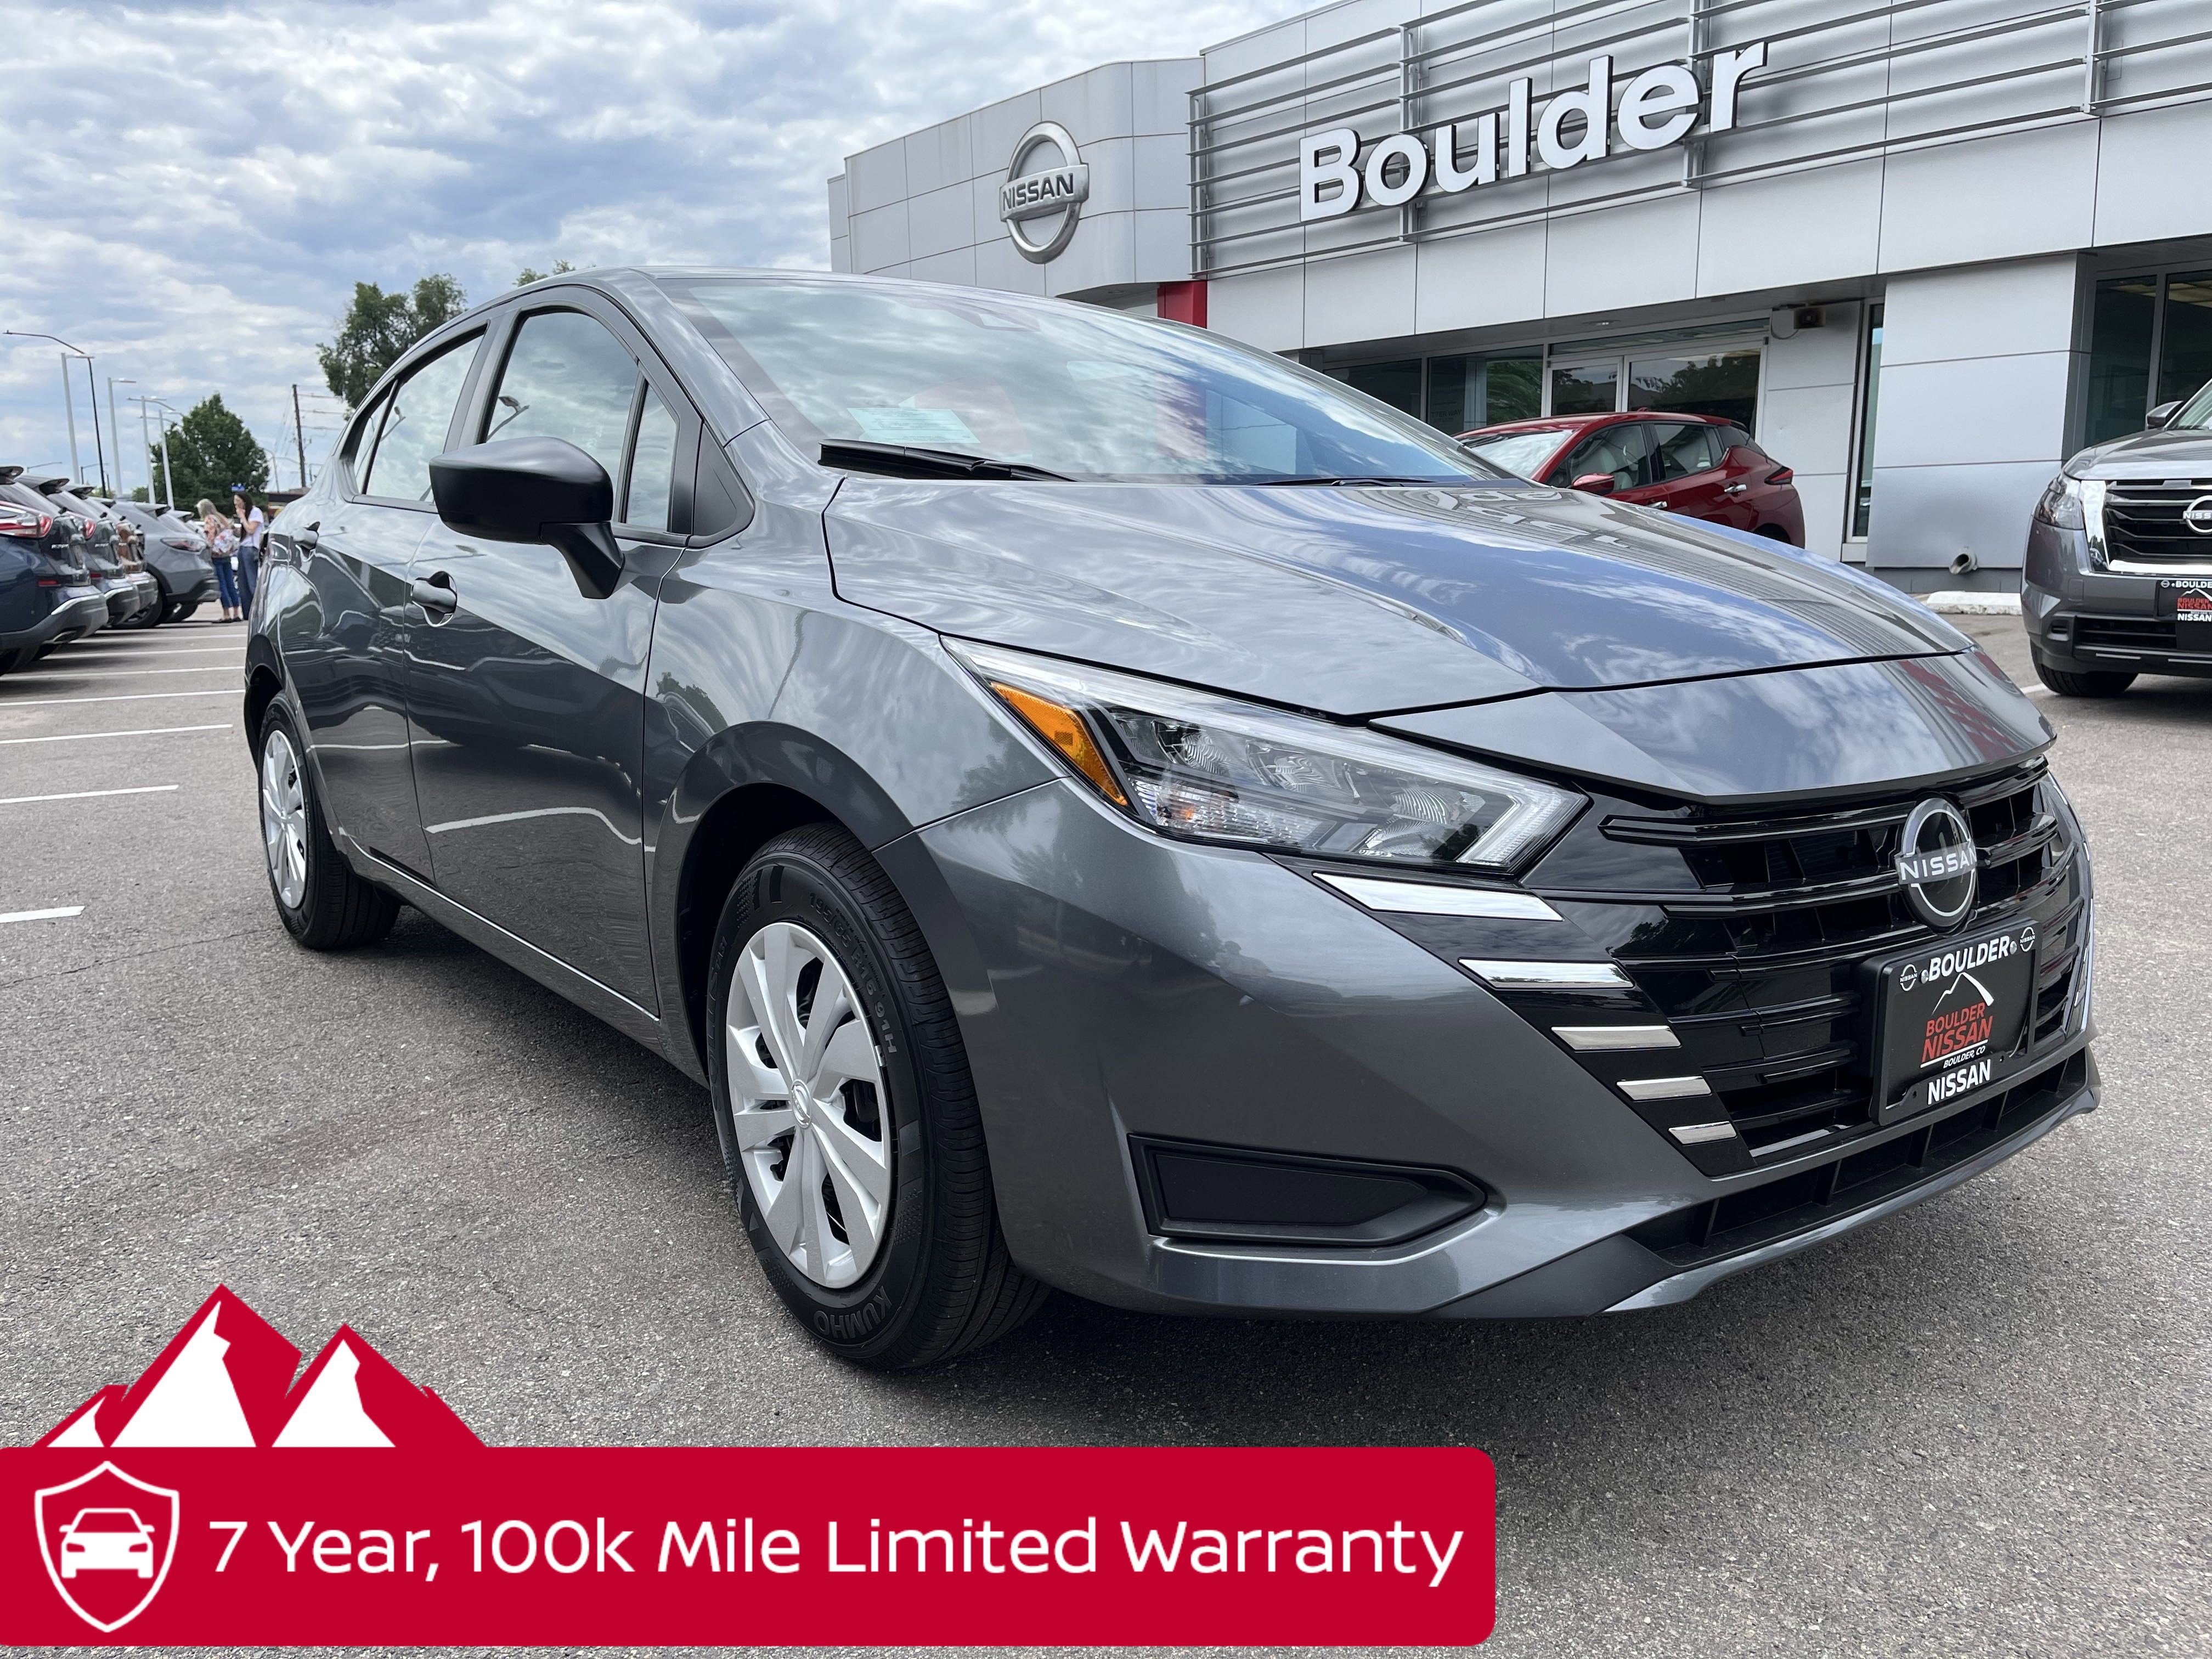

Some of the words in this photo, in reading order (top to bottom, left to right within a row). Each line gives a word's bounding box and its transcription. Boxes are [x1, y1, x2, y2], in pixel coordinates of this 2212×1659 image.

[1300, 42, 1768, 222] Boulder
[1002, 172, 1074, 212] NISSAN
[2177, 613, 2212, 622] NISSAN
[1899, 845, 1977, 881] NISSAN
[1928, 935, 2009, 981] BOULDER
[2019, 934, 2035, 944] NISSAN
[1899, 973, 1917, 983] NISSAN
[874, 1000, 898, 1053] 91H
[1922, 1015, 1993, 1063] NISSAN
[1926, 1002, 1985, 1037] BOULDER
[1976, 1045, 1986, 1057] CO
[1927, 1059, 1991, 1105] NISSAN
[814, 1285, 893, 1339] KUMHO
